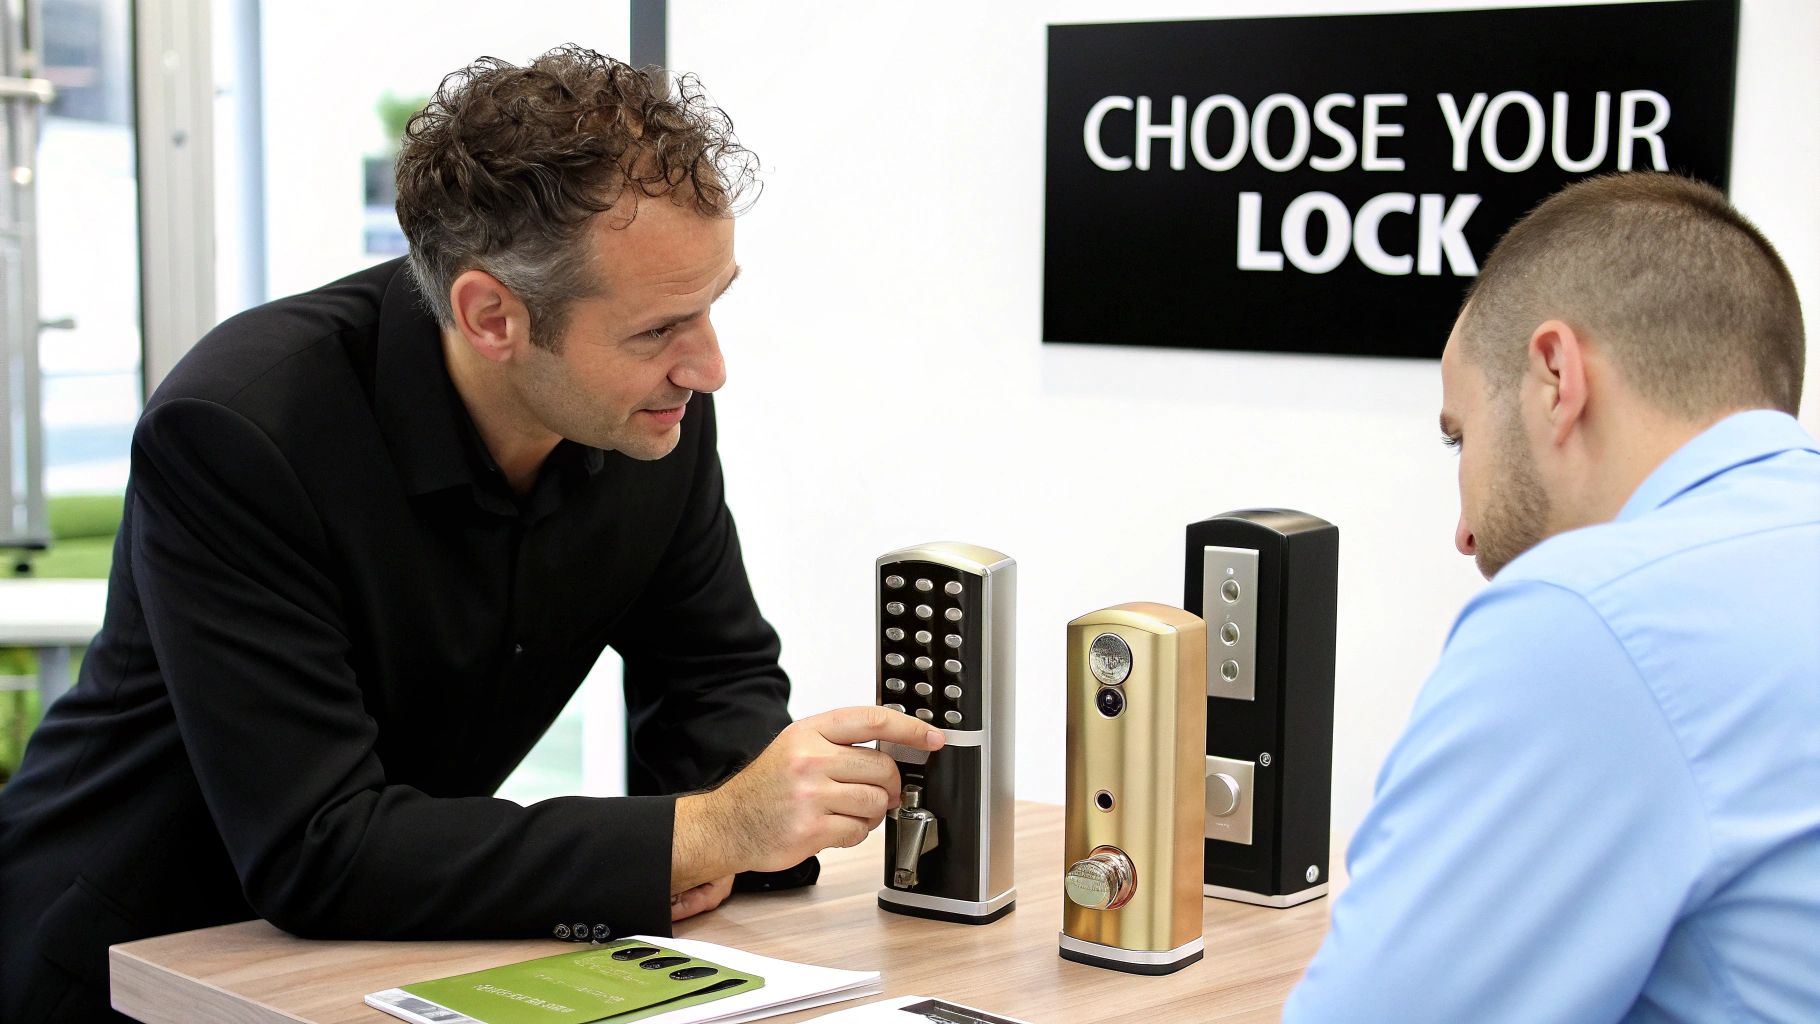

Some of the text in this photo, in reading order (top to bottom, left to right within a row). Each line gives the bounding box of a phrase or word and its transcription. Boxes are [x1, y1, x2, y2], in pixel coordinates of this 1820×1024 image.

[1083, 90, 1671, 173] CHOOSE YOUR
[1236, 191, 1482, 277] LOCK
